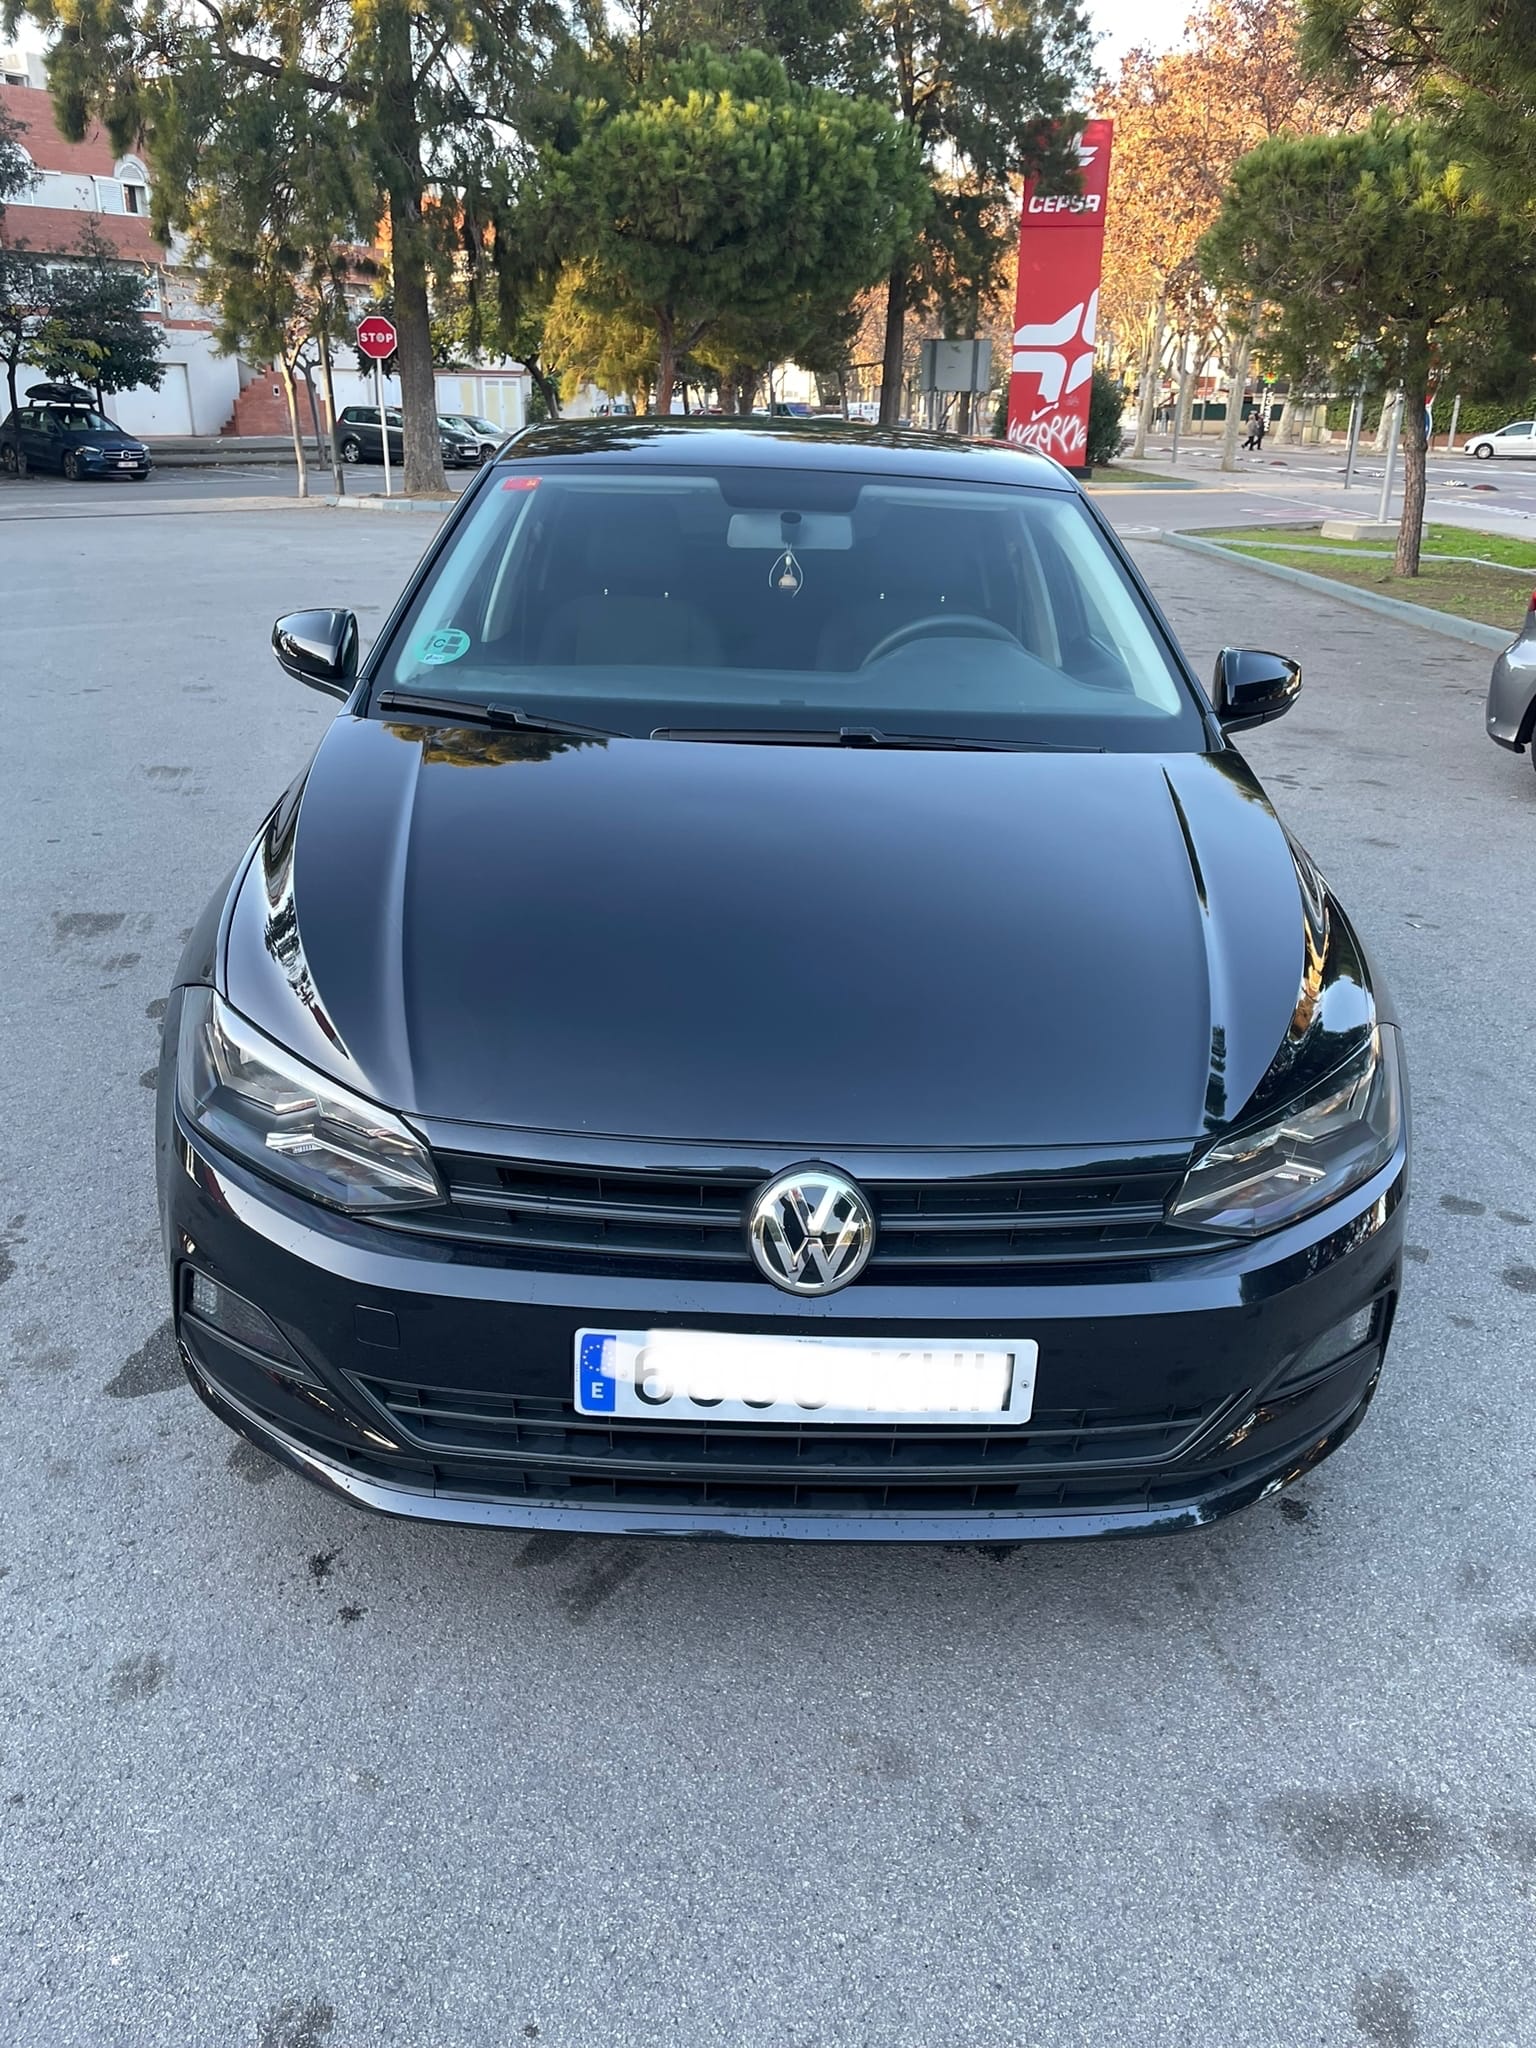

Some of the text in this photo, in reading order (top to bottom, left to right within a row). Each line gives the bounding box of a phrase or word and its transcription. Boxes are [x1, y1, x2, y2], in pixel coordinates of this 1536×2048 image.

[1028, 194, 1101, 214] CEPSA
[360, 332, 394, 343] STOP
[755, 1177, 869, 1291] VW
[591, 1381, 605, 1399] E
